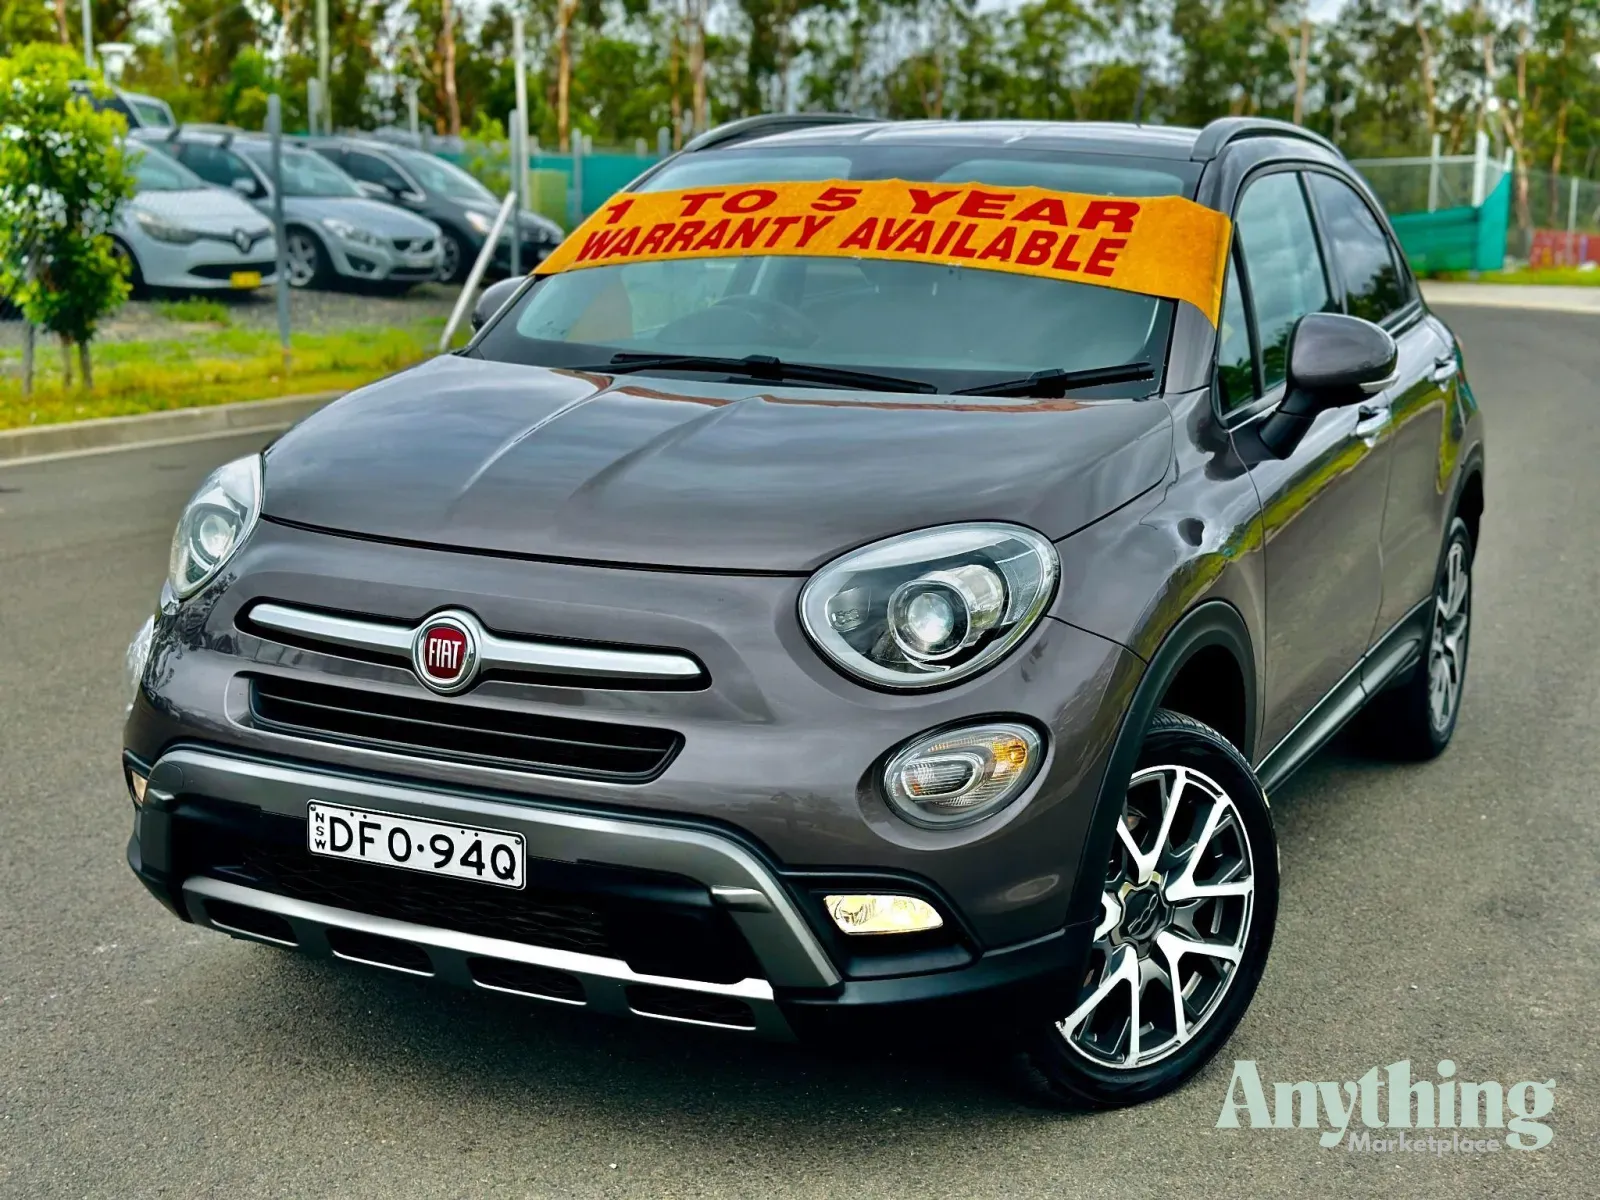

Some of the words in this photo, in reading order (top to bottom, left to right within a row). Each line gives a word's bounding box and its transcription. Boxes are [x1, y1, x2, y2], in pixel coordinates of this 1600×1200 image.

[606, 199, 634, 225] 1
[680, 189, 778, 217] TO
[810, 187, 863, 212] 5
[908, 188, 1141, 233] YEAR
[575, 215, 836, 262] WARRANTY
[838, 216, 1128, 277] AVAILABLE
[428, 637, 463, 670] FIAT
